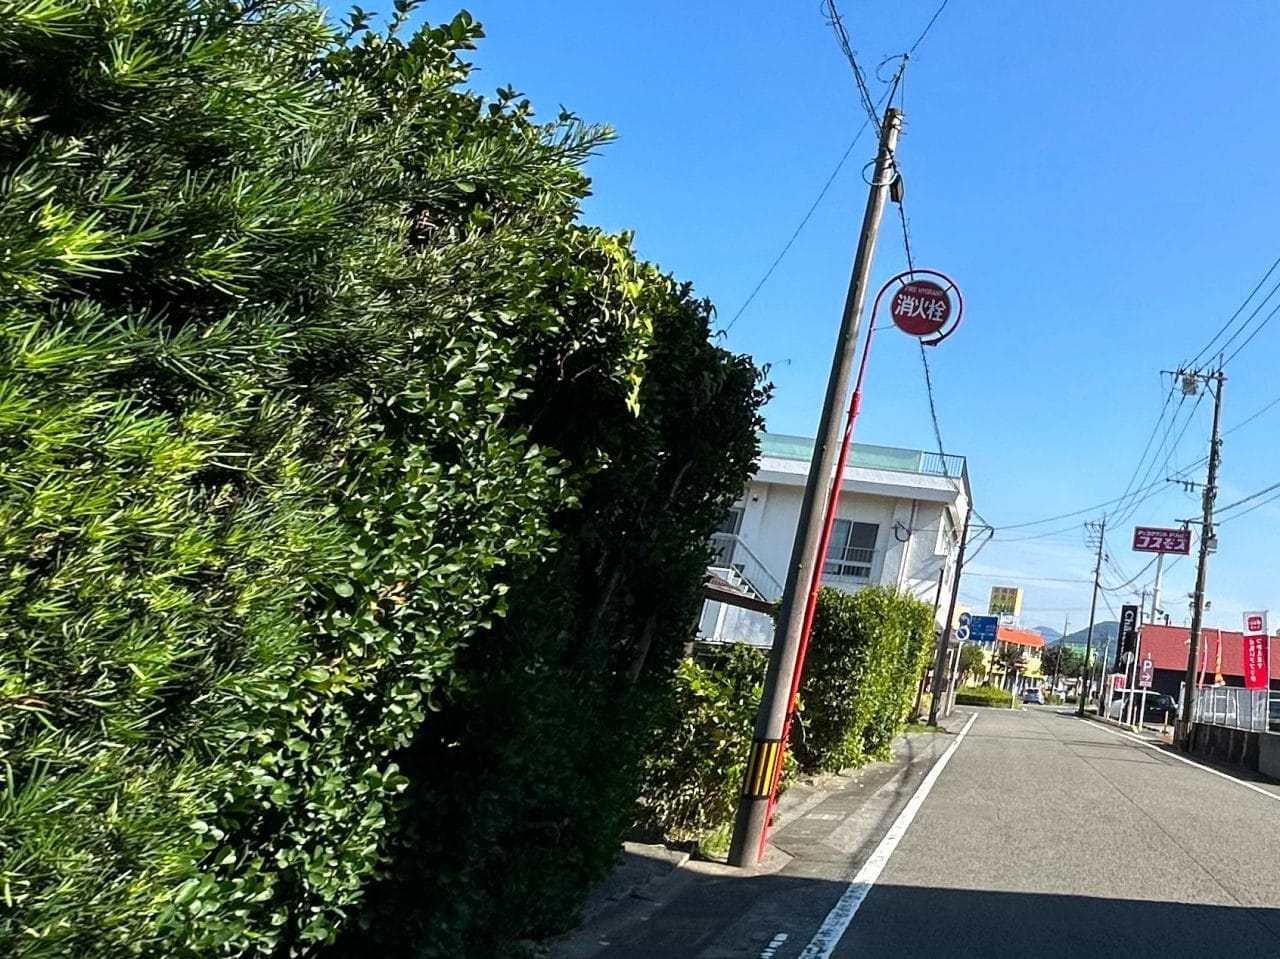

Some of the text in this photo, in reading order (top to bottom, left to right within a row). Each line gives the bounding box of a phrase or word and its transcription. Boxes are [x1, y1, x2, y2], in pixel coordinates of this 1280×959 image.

[894, 294, 946, 322] 消火栓
[1136, 536, 1185, 550] コスモス
[1143, 659, 1152, 673] P
